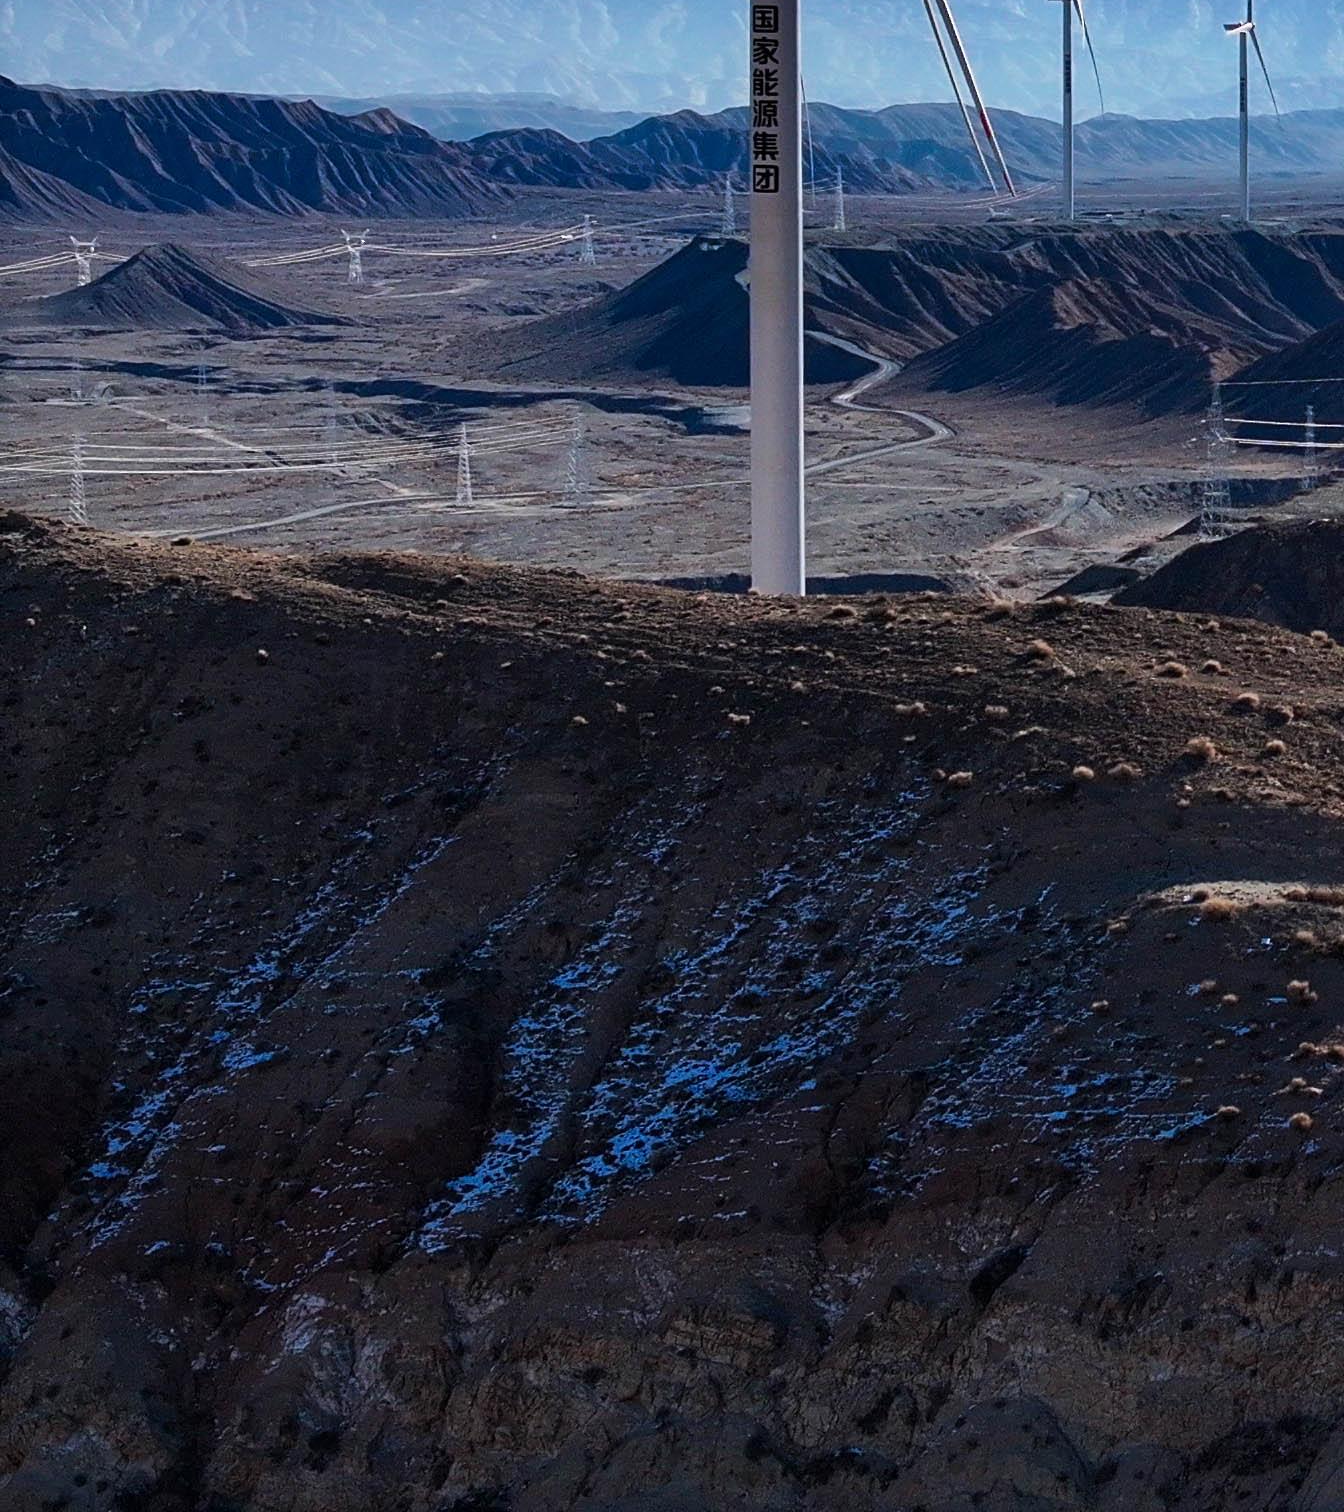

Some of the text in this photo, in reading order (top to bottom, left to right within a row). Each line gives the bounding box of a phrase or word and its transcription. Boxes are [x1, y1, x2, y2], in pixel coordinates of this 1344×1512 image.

[752, 4, 780, 194] 国家能源集团
